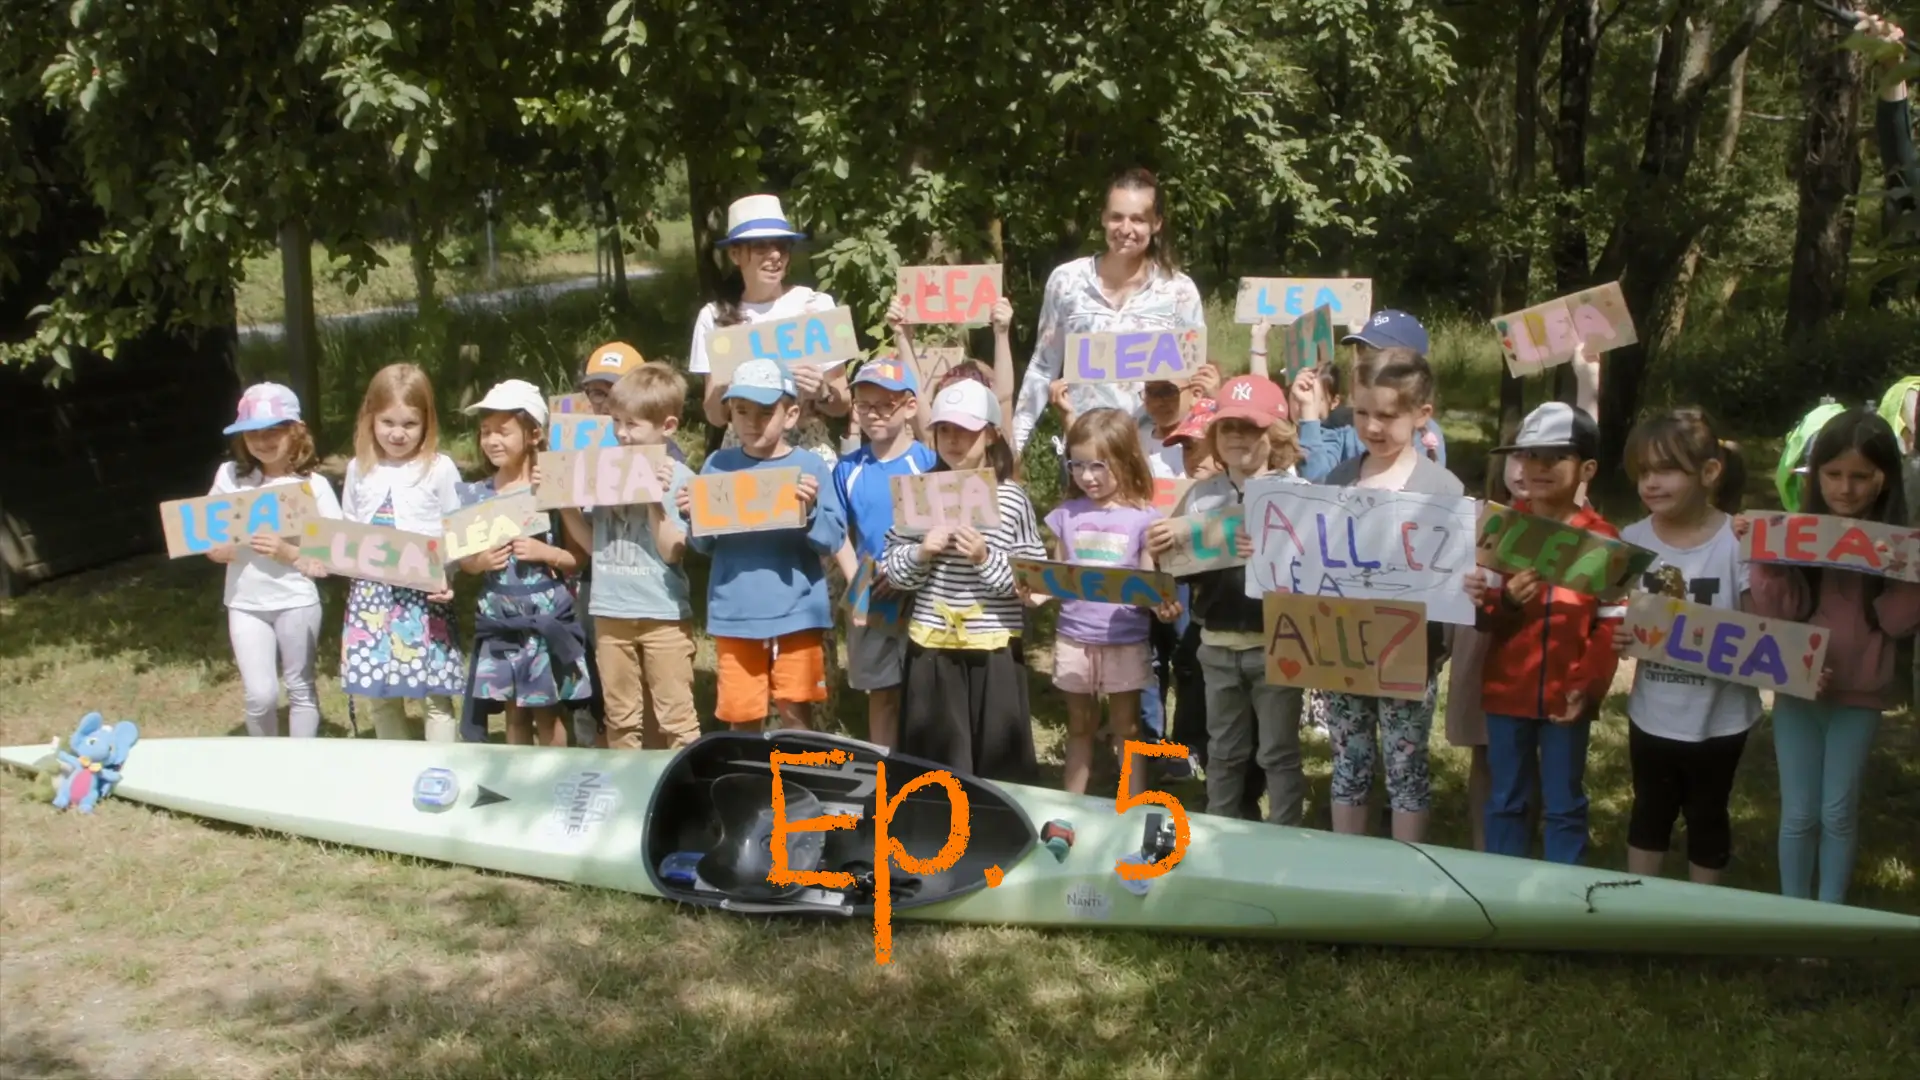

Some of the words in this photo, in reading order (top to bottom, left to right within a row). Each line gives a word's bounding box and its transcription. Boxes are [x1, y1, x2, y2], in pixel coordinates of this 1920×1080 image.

[915, 270, 997, 323] LEA
[1257, 286, 1342, 315] LEA
[748, 317, 831, 360] LEA
[1078, 332, 1183, 379] LEA
[573, 445, 663, 506] LEA
[902, 472, 998, 527] LEA
[179, 492, 280, 552] LEA
[1262, 501, 1452, 573] ALLEZ
[1752, 516, 1882, 567] LEA
[331, 532, 430, 576] LEA
[1498, 518, 1609, 591] LEA
[1042, 568, 1164, 603] LEA
[1269, 606, 1423, 691] ALLEZ
[1665, 615, 1788, 685] LEA
